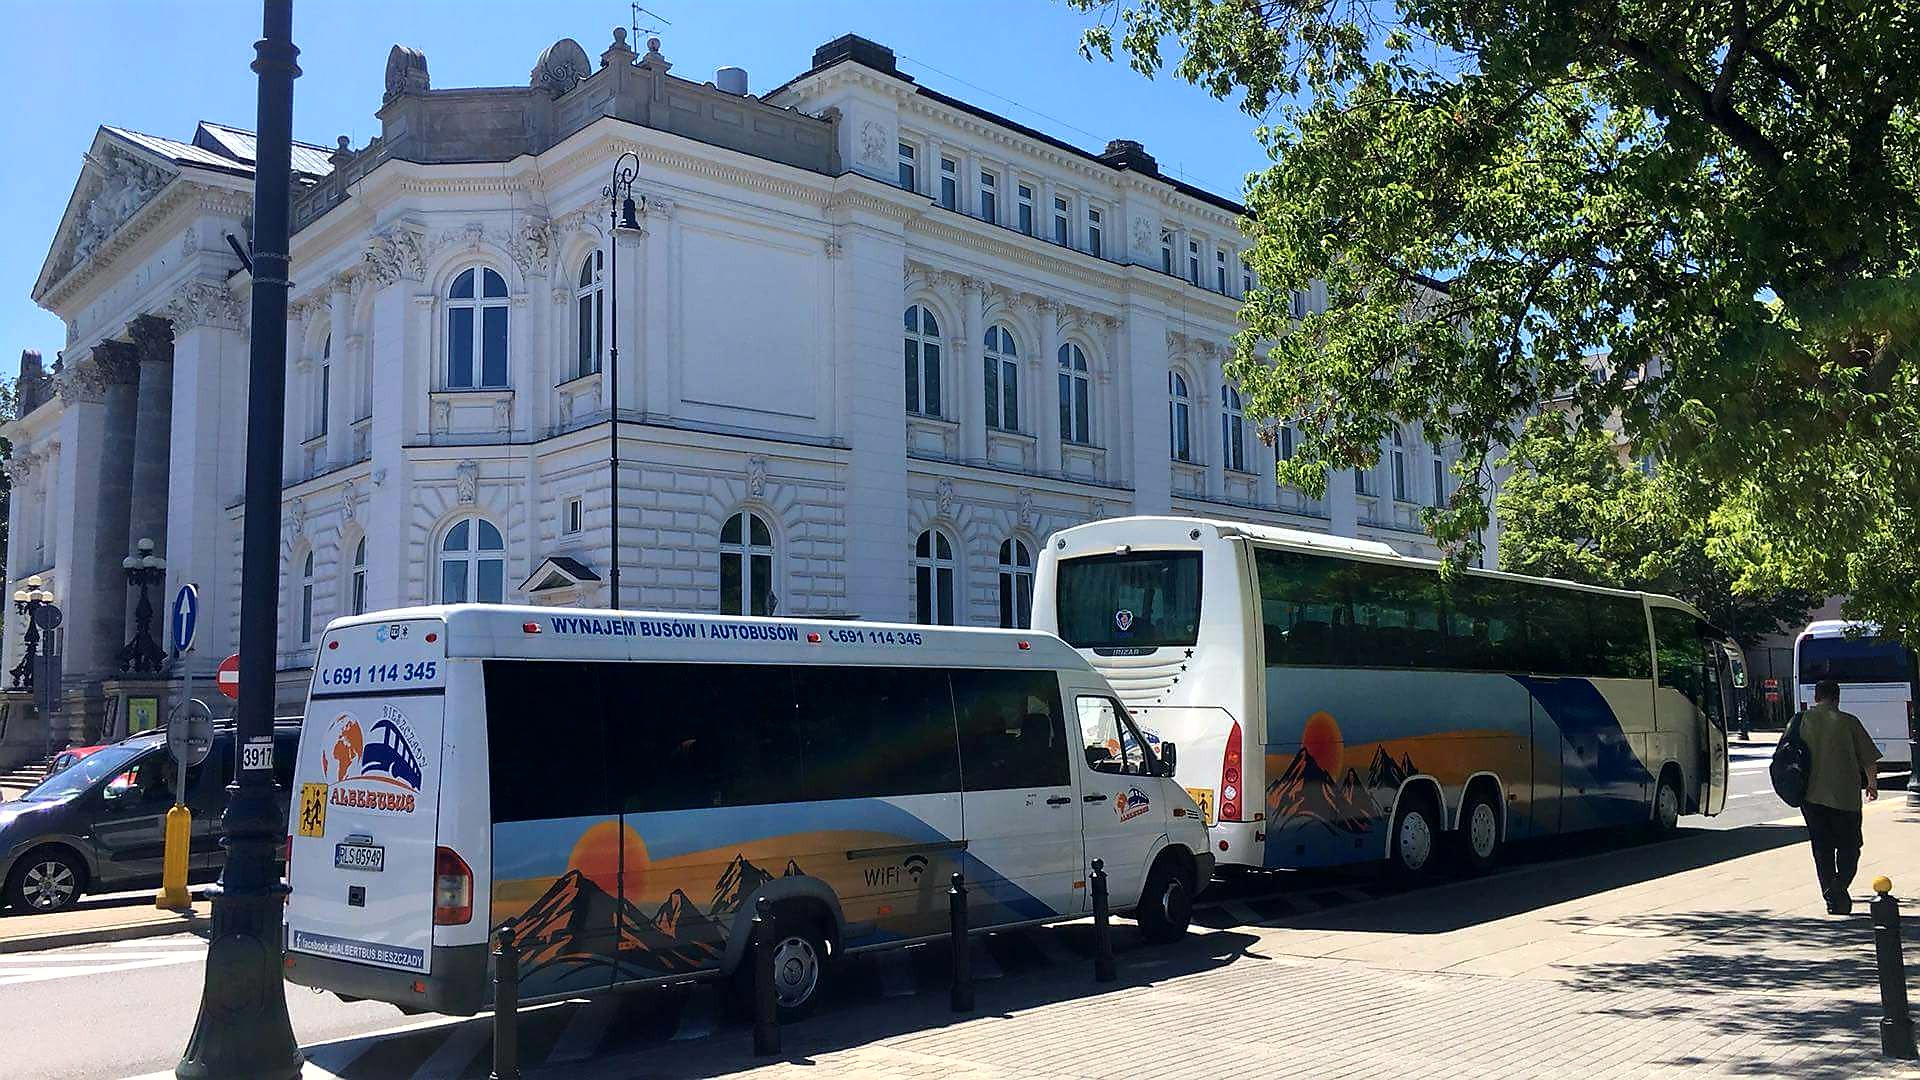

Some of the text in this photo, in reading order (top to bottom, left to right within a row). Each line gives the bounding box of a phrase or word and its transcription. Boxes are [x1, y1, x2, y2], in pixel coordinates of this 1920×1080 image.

[551, 617, 798, 641] WYNAJEM BUSÓW I AUTOBUSÓW
[838, 630, 922, 645] 691 114 345
[333, 661, 436, 685] 691 114 345
[244, 747, 272, 767] 3917
[330, 787, 416, 813] ALBERTBUS
[340, 847, 381, 866] RLS 05949
